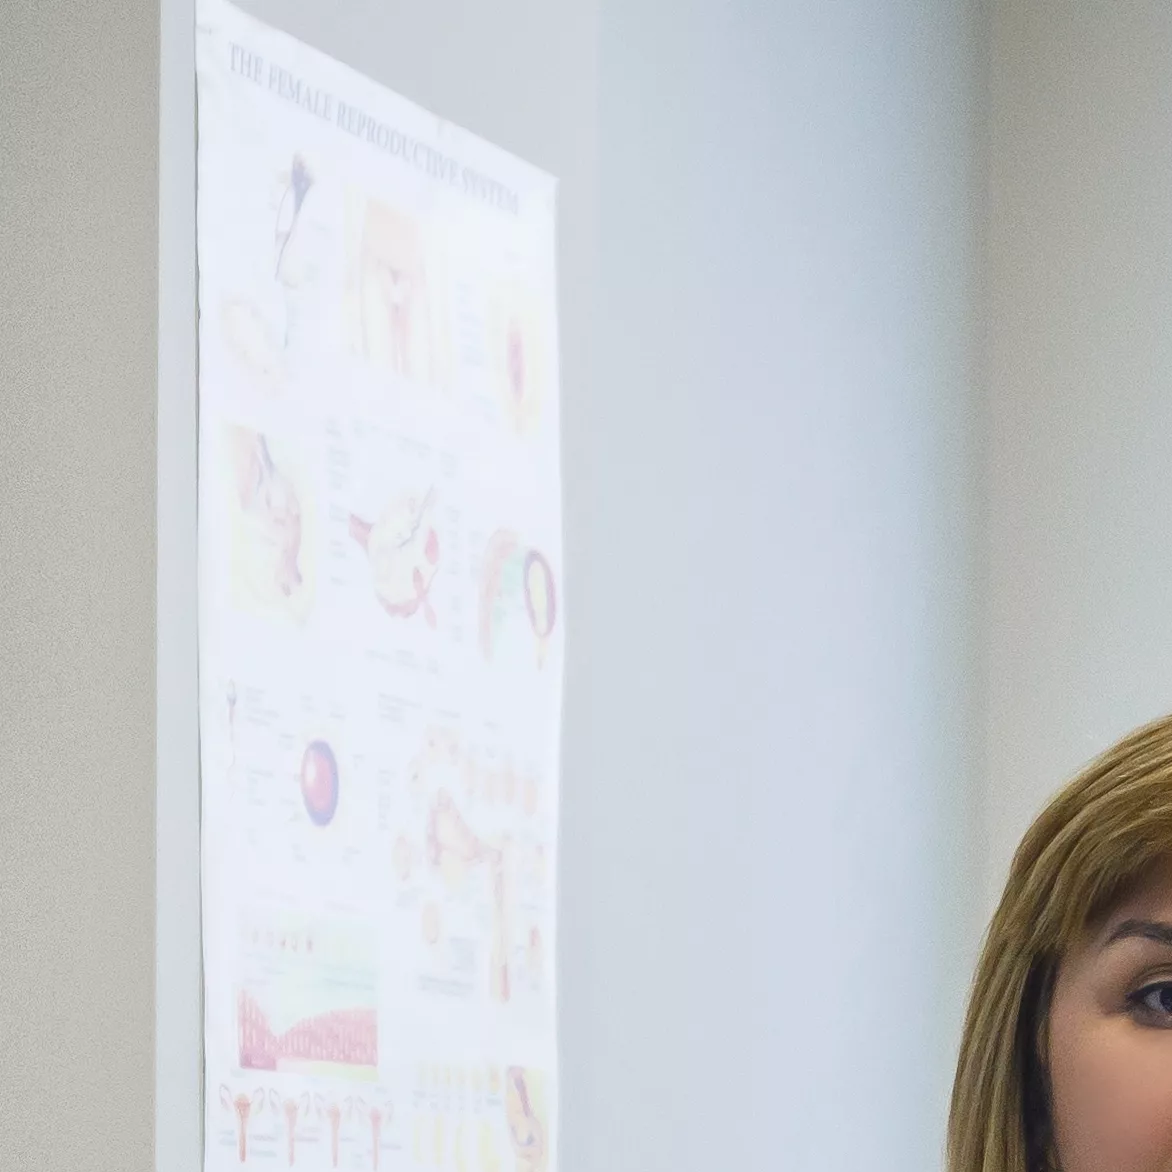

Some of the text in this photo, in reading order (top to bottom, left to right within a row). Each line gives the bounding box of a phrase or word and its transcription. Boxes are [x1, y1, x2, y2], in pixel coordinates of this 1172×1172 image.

[228, 41, 519, 216] THE FEMALE REPRODUCTIVE SYSTEM
